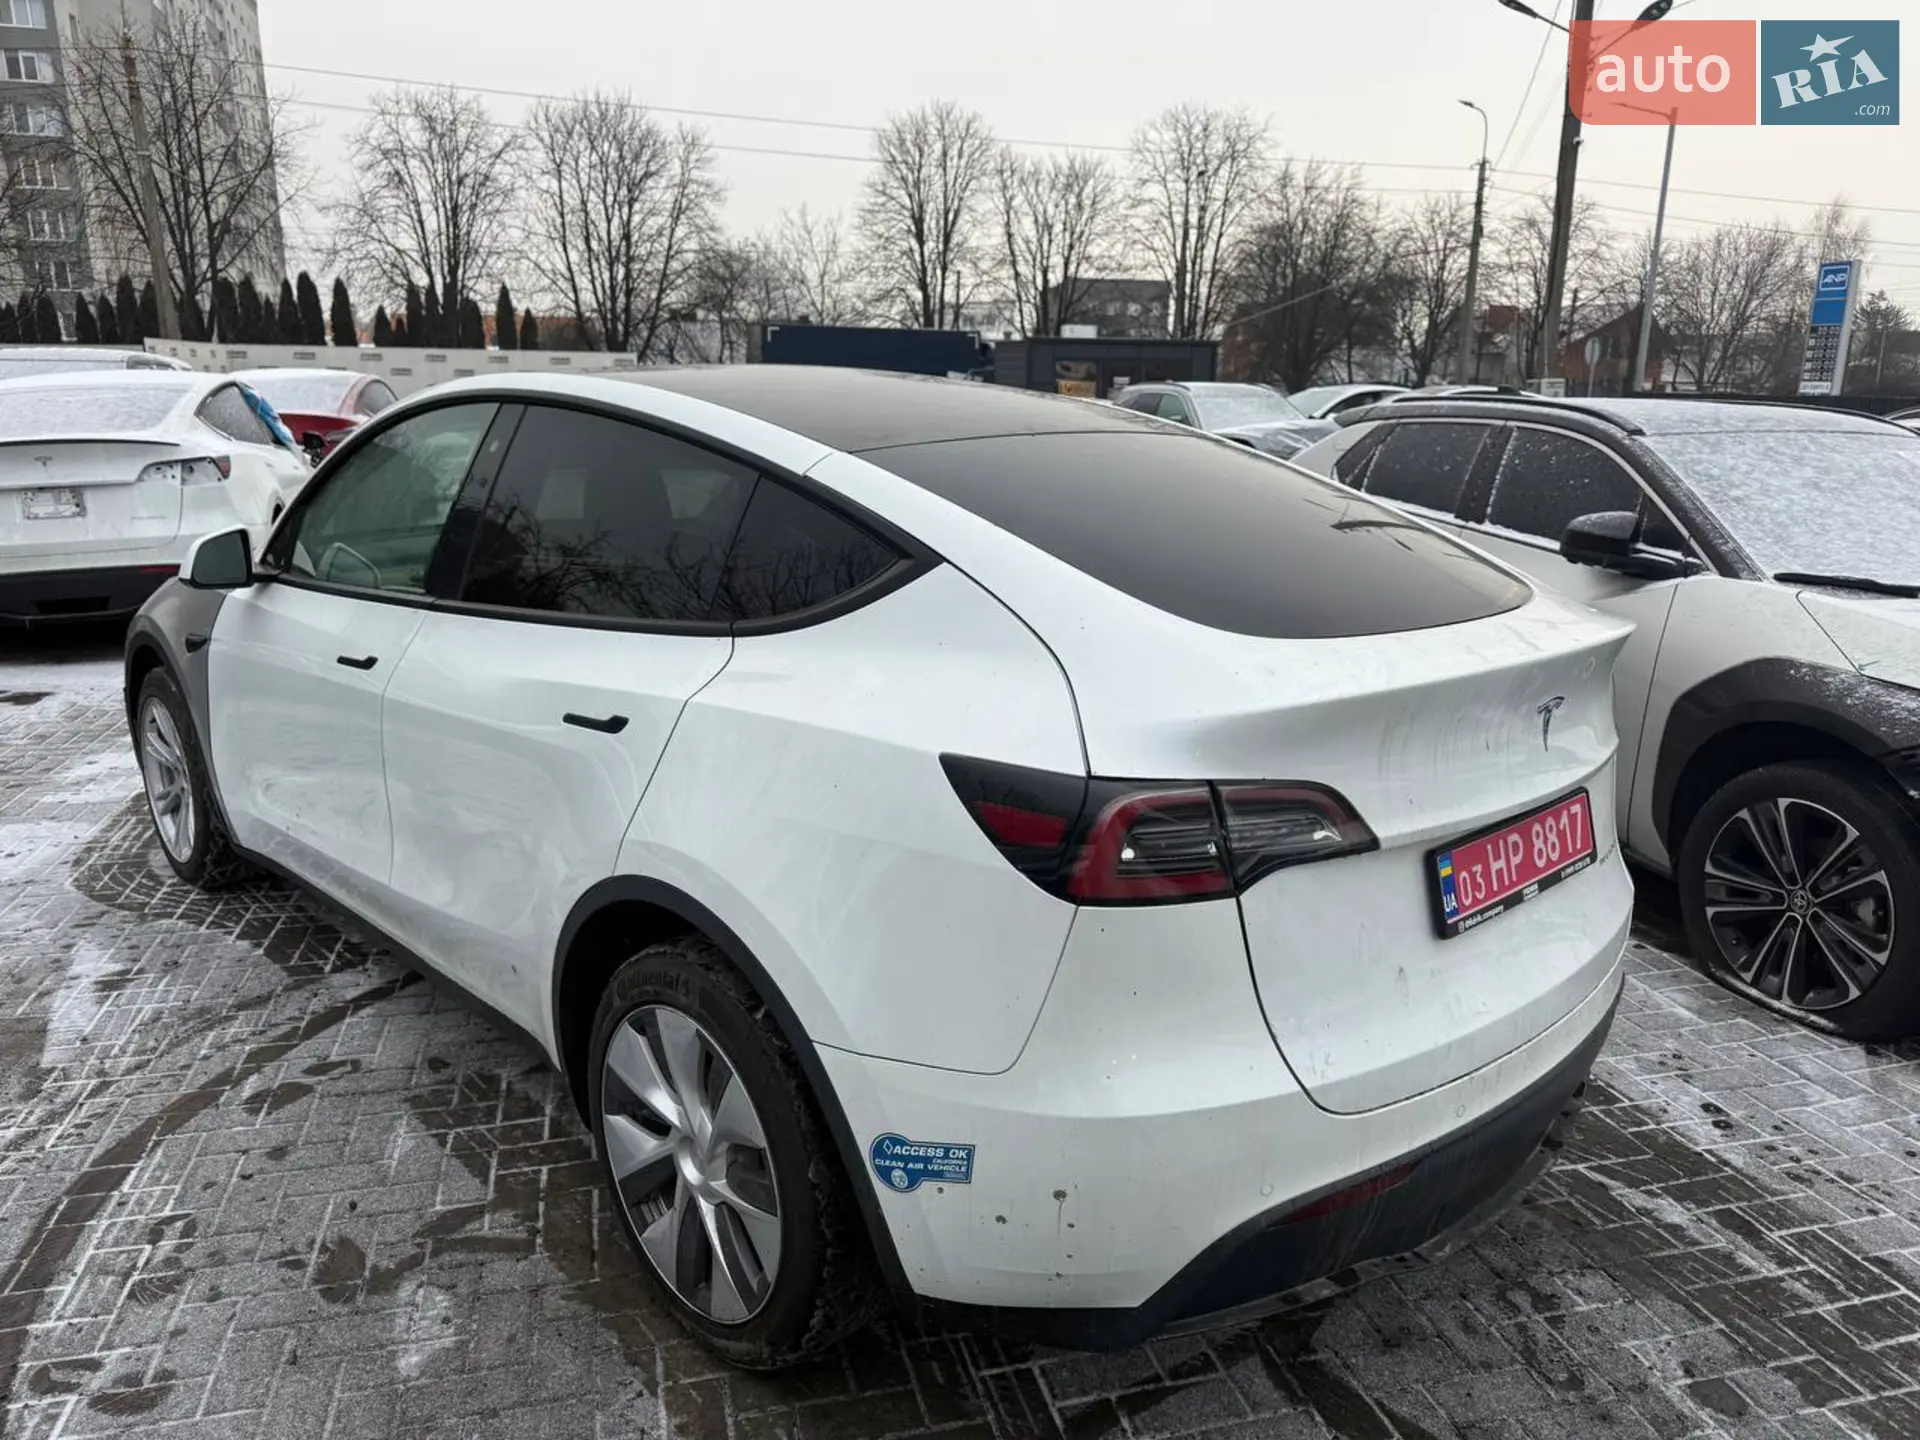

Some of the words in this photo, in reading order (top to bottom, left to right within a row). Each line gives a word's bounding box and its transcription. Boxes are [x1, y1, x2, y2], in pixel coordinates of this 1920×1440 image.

[1459, 863, 1486, 907] 03
[1487, 832, 1523, 892] HP
[1531, 803, 1582, 869] 8817
[1443, 892, 1458, 912] UA
[893, 1145, 944, 1157] ACCESS
[949, 1148, 968, 1159] OK
[875, 1159, 905, 1168] CLEAN
[907, 1162, 924, 1170] AIR
[927, 1164, 968, 1172] VEHICLE
